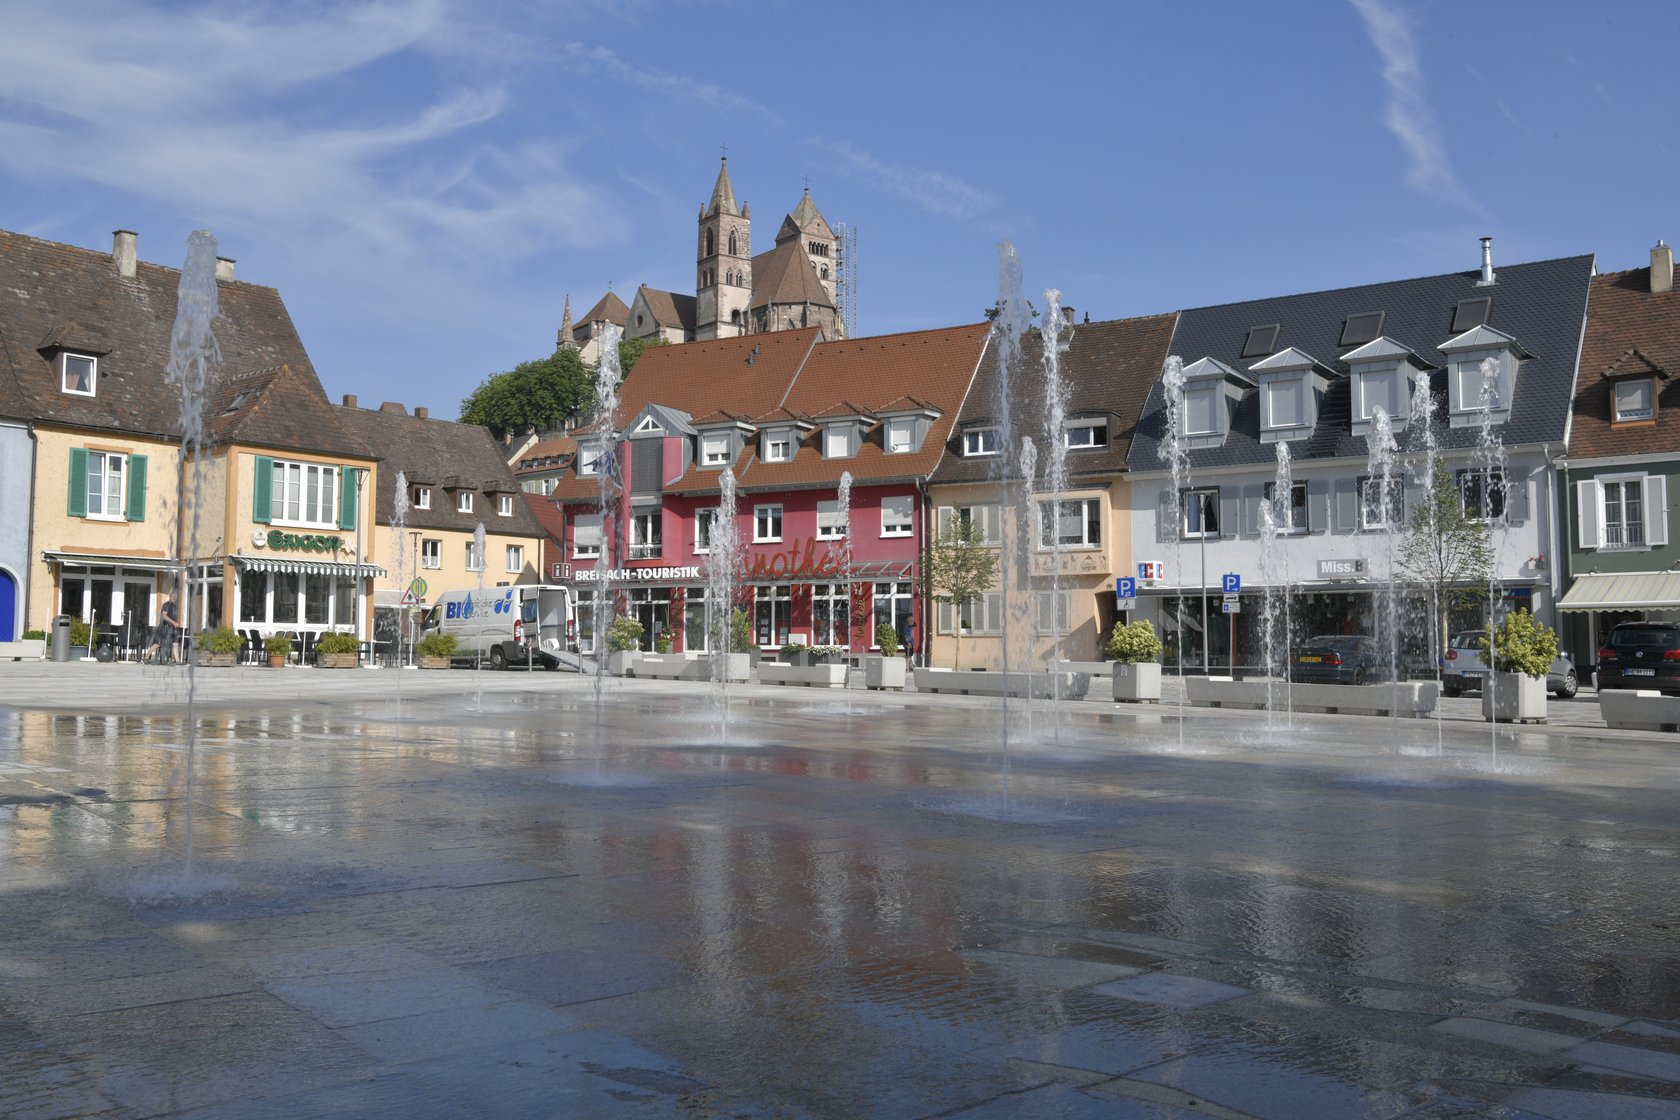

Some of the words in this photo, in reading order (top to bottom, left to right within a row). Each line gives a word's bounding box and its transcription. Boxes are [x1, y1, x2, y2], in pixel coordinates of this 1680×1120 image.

[1321, 560, 1364, 574] Miss.B
[1120, 580, 1131, 596] P
[1226, 576, 1237, 591] P
